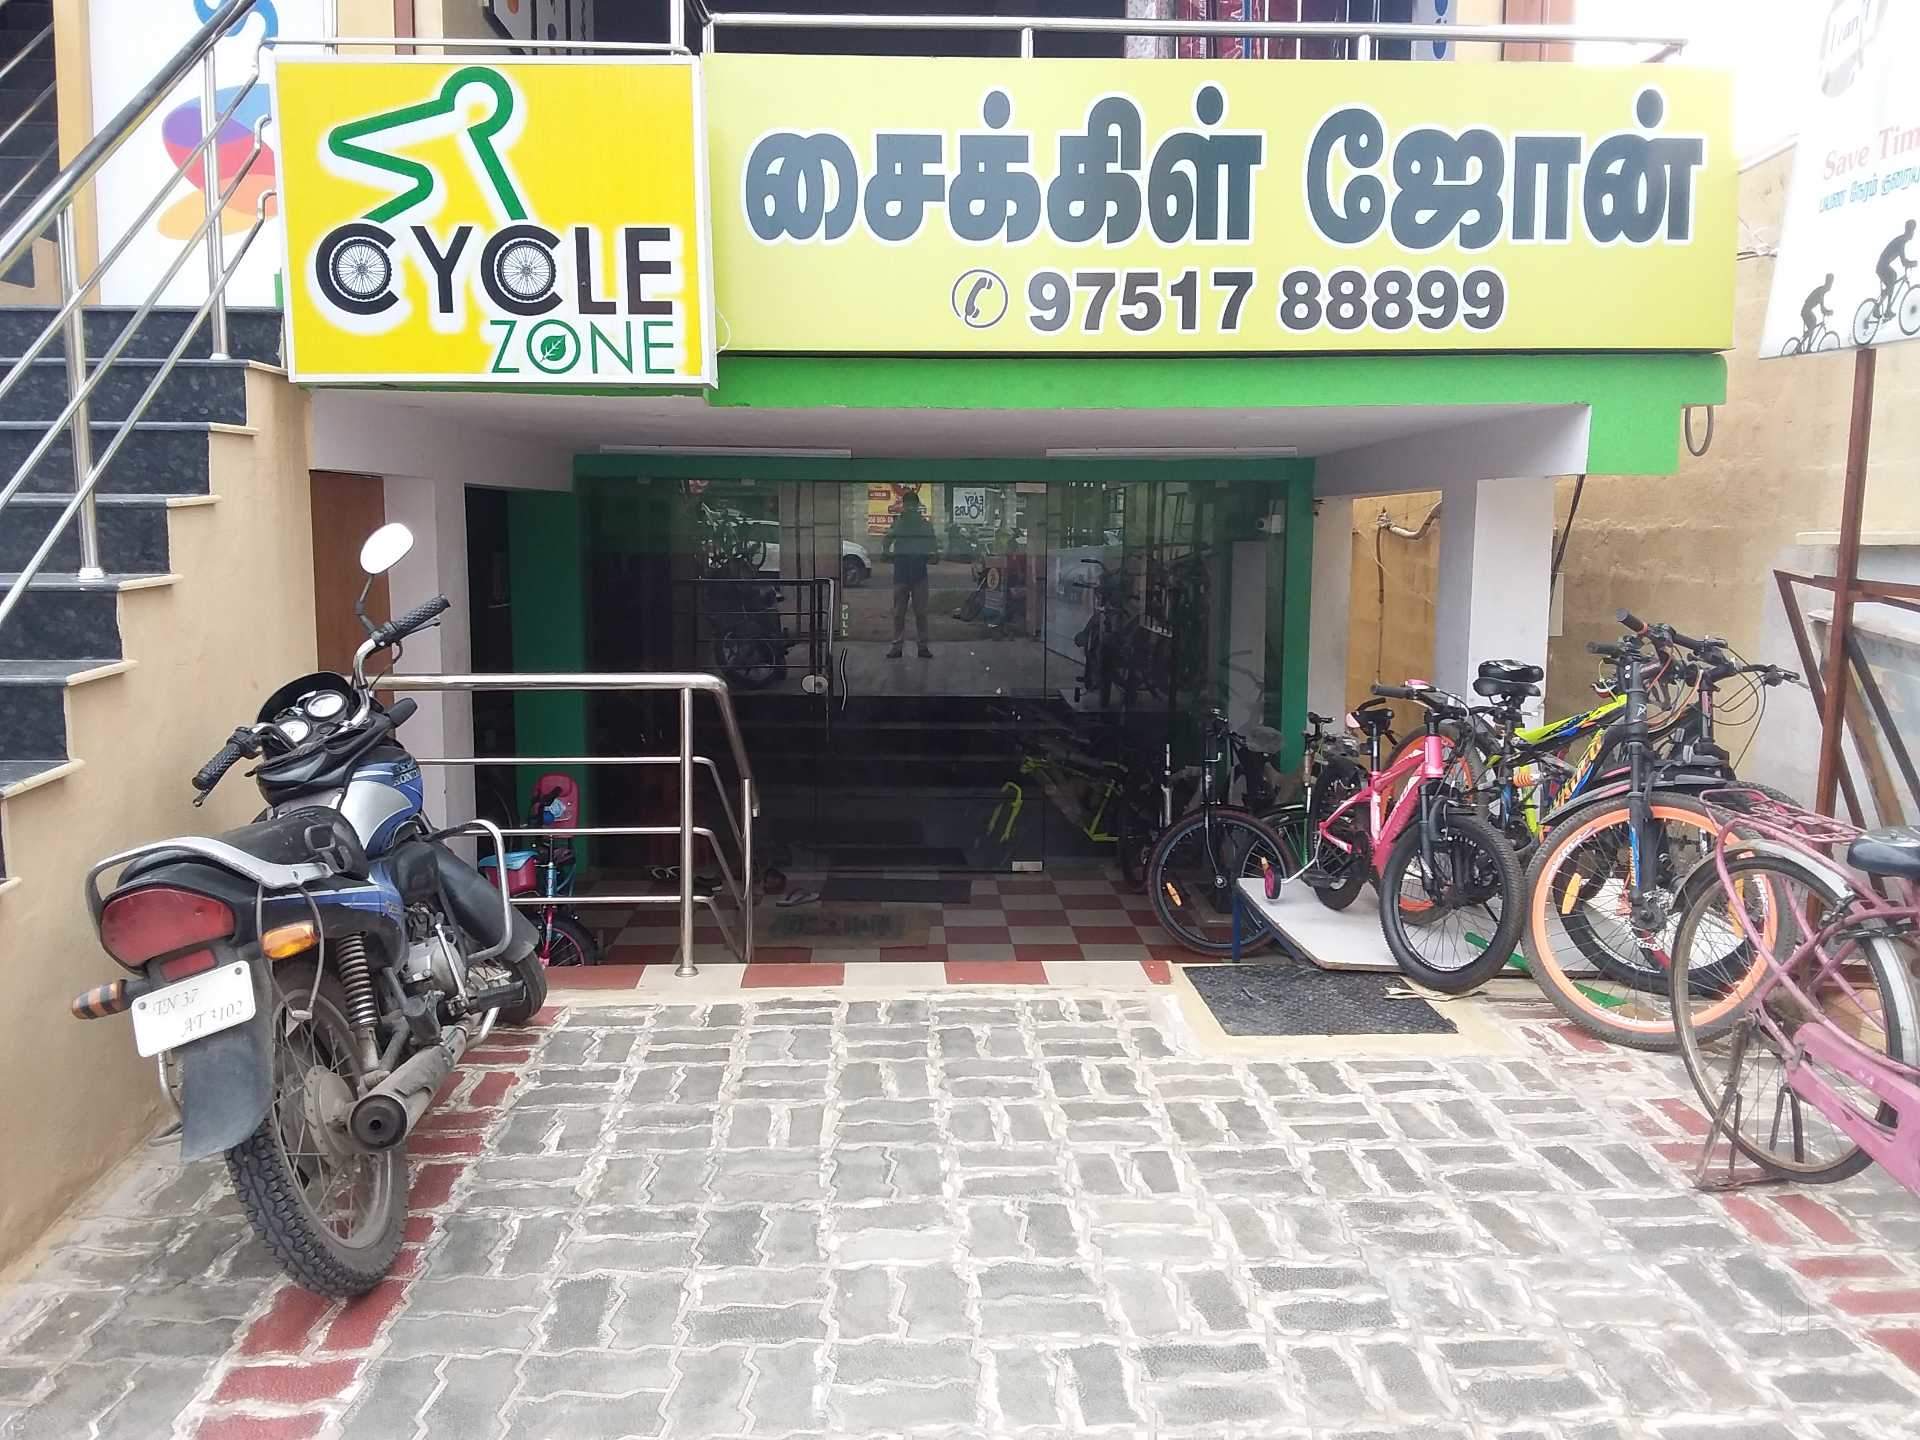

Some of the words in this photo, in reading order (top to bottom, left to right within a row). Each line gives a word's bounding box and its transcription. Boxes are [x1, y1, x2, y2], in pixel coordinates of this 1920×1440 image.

[745, 85, 1263, 245] சைக்கிள்
[1306, 88, 1704, 250] ஜோன்
[1823, 147, 1870, 180] Save
[316, 223, 674, 316] CYCLE
[1027, 270, 1254, 332] 97517
[1280, 269, 1505, 331] 88899
[490, 319, 676, 374] ZONE
